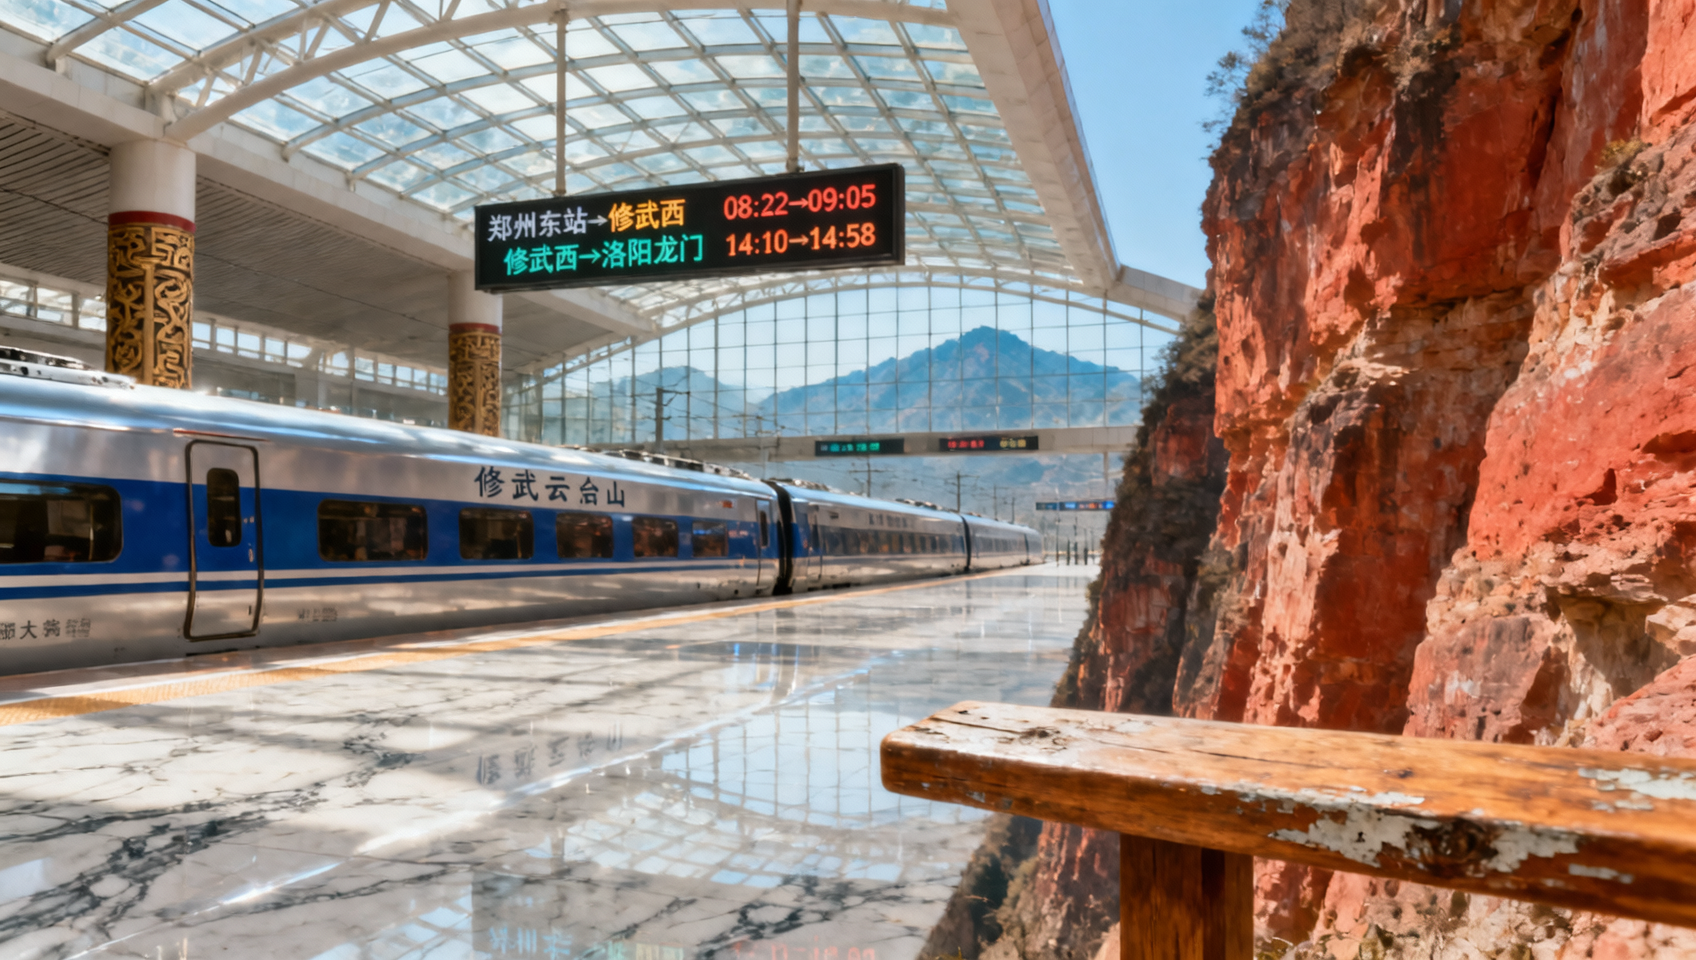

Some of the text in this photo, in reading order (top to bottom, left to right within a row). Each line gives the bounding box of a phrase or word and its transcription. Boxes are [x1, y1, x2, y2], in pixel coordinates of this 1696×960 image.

[487, 184, 877, 242] 郑州东站 修武西 08:22 09:05
[504, 222, 877, 276] 修武西 洛阳龙门 14:10 14:58
